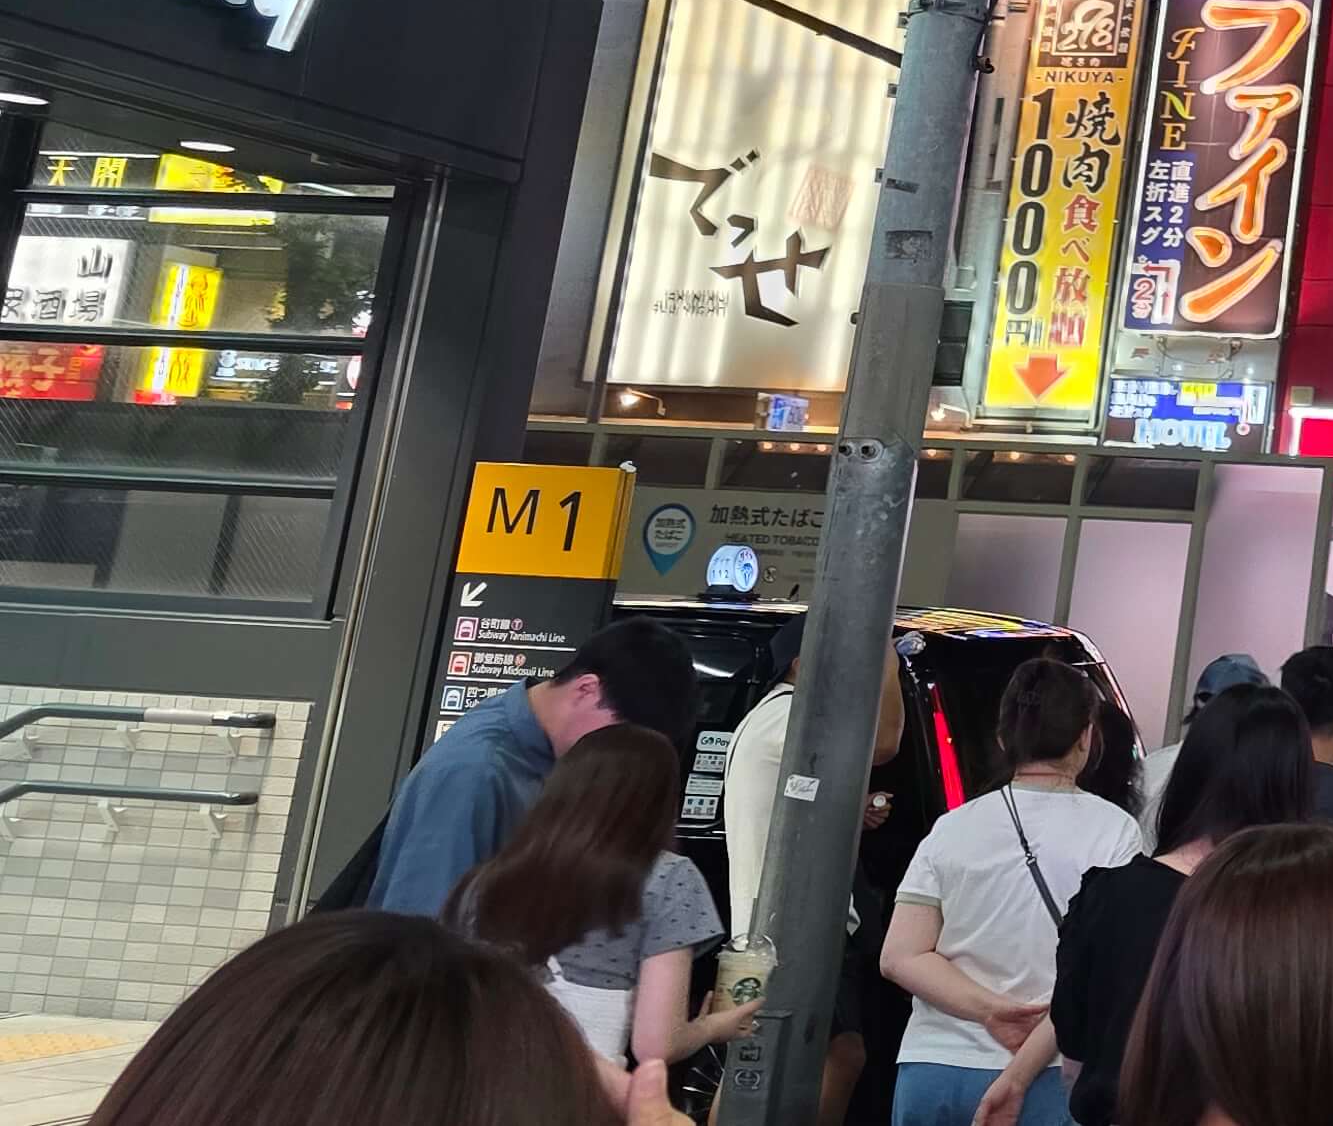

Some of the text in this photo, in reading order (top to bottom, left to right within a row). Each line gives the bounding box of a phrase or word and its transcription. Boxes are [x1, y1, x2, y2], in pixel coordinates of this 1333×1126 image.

[1159, 27, 1206, 151] FINE
[1141, 159, 1171, 245] 左折スグ
[1163, 160, 1194, 248] 直進2分
[711, 504, 824, 530] 加熱式たばこ
[478, 629, 508, 643] Subway
[549, 633, 566, 643] Line
[471, 663, 501, 677] Subway
[538, 668, 556, 678] Line
